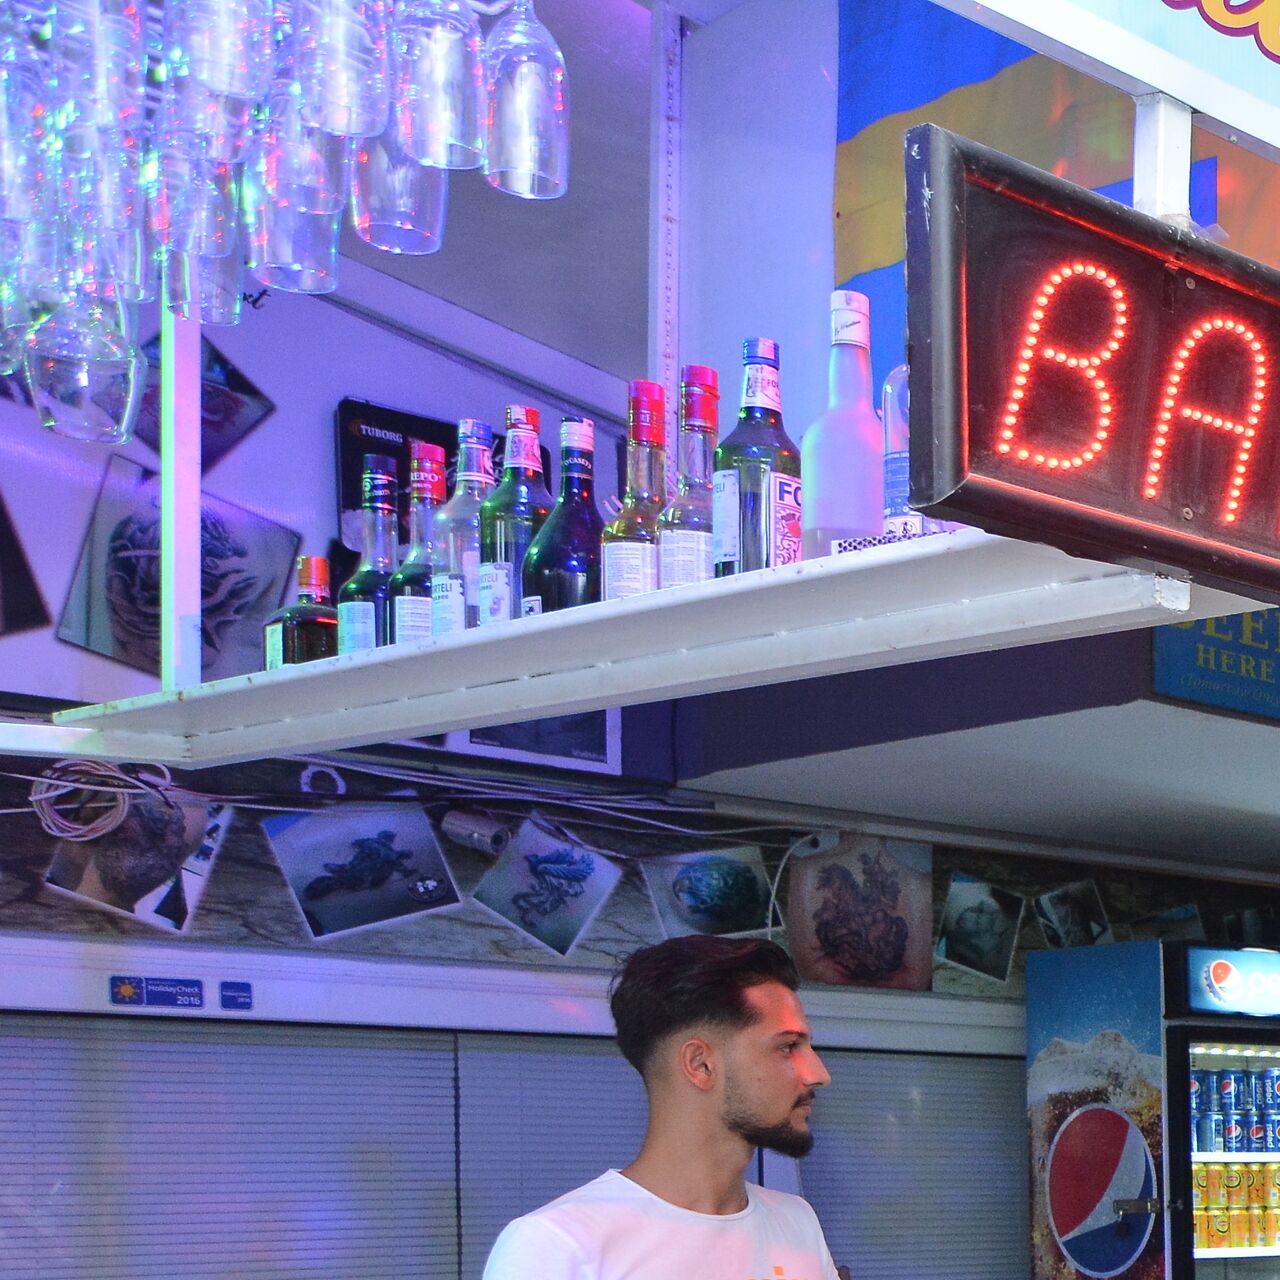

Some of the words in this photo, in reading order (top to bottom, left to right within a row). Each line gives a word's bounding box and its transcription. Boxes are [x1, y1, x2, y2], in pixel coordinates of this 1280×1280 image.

[360, 425, 403, 442] TUBORG
[1196, 644, 1275, 684] HERE
[177, 996, 200, 1005] 2016
